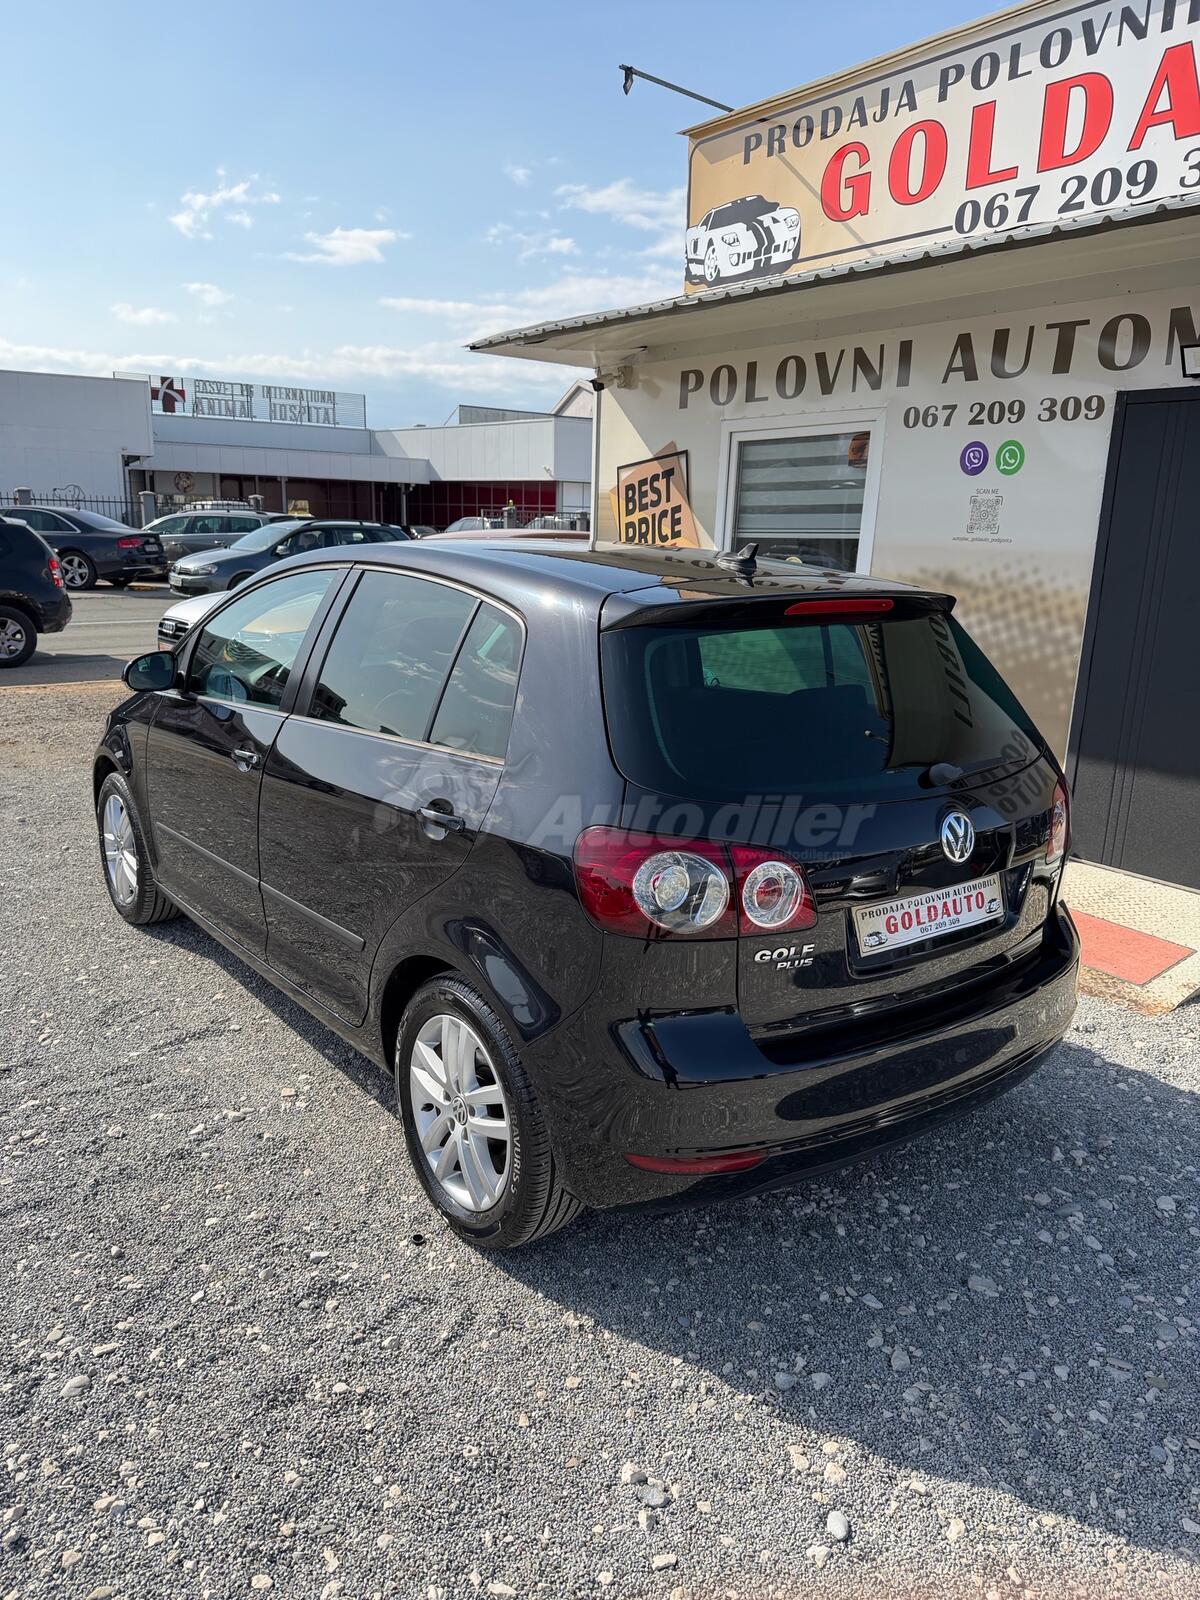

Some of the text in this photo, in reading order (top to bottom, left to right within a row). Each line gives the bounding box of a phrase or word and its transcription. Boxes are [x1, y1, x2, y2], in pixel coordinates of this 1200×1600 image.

[743, 79, 918, 165] PRODAJA
[954, 185, 1041, 235] 067
[1057, 159, 1159, 215] 209
[678, 340, 913, 410] POLOVNI
[195, 397, 340, 426] ANIMAL HOSPITAL
[903, 394, 1106, 429] 067 209 309
[624, 467, 675, 517] BEST
[624, 504, 682, 545] PRICE
[860, 877, 997, 921] PRODAJA POLOVNIH AUTOMOBILA
[885, 891, 986, 935] GOLDAUTO
[919, 917, 961, 934] 067 209 309
[754, 943, 816, 964] GOLF
[776, 957, 814, 971] PLUS
[509, 1103, 521, 1194] BRAVURIS 5
